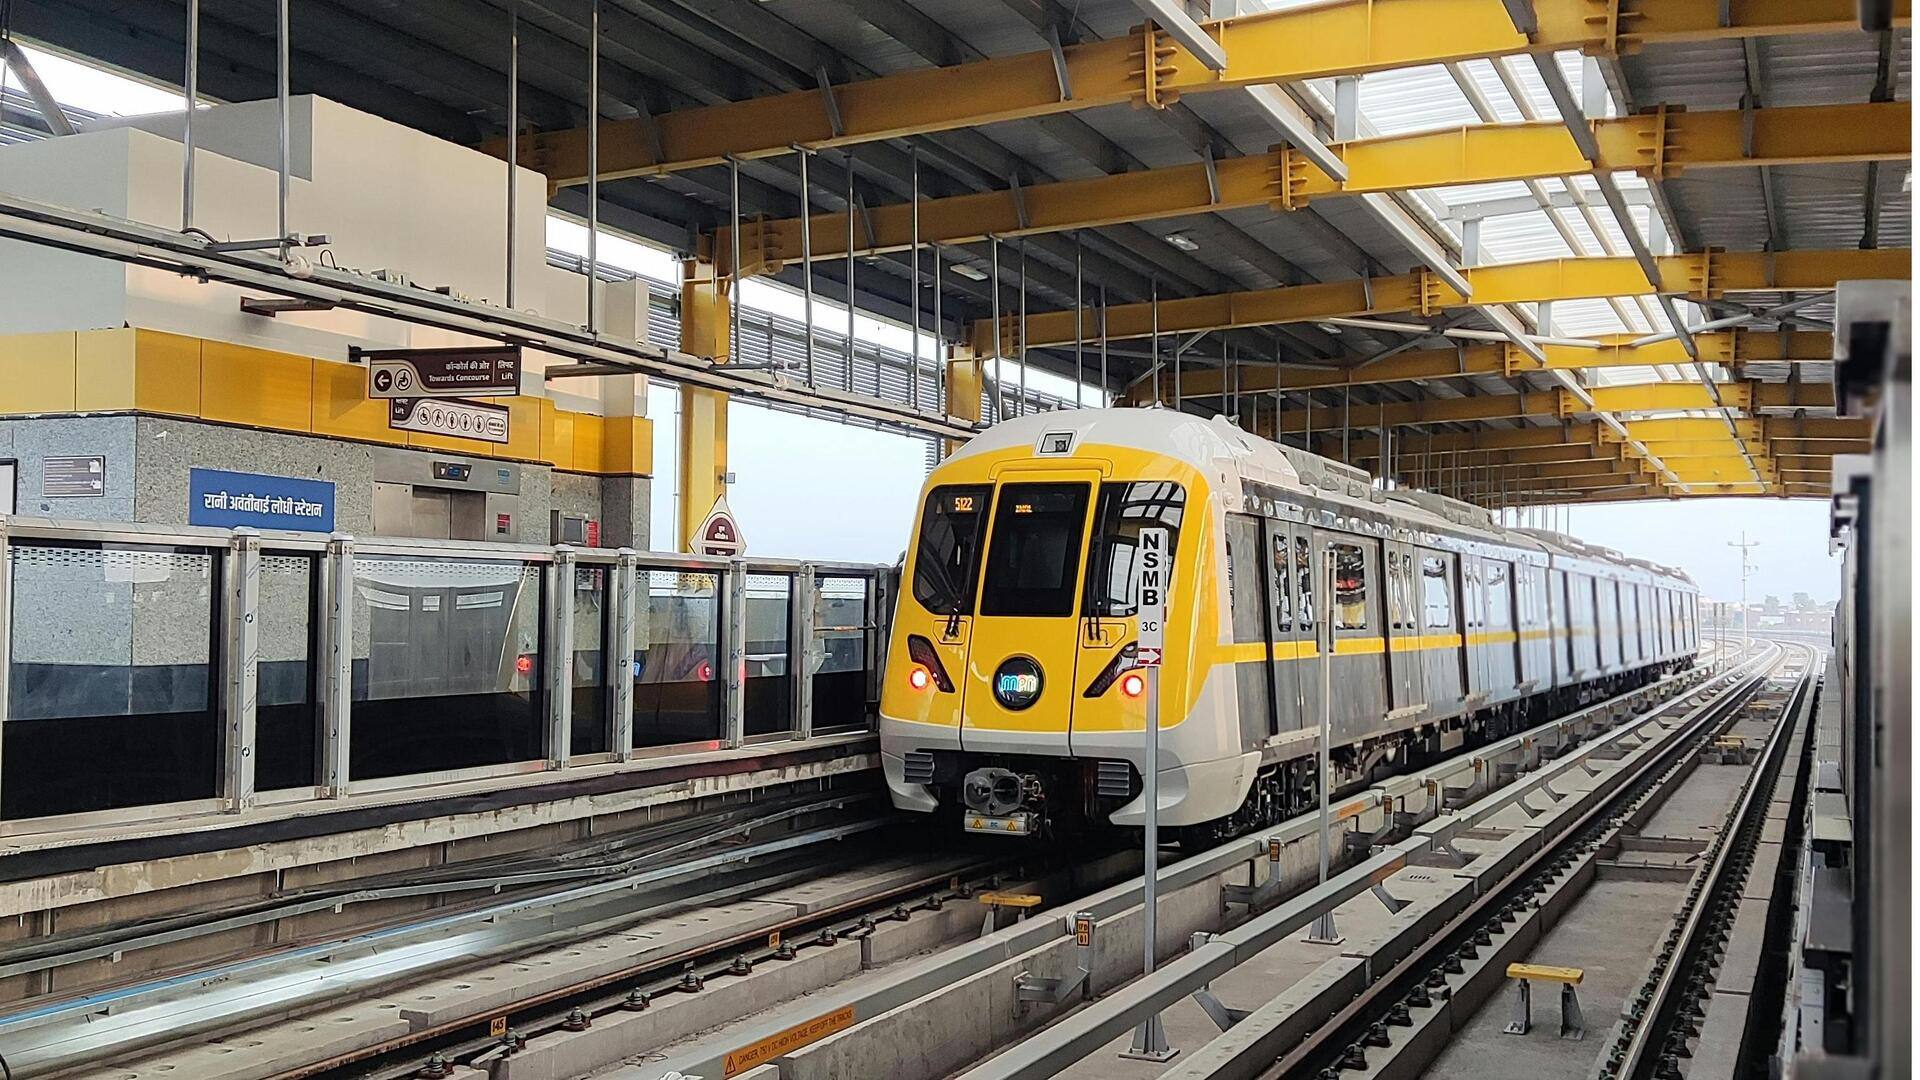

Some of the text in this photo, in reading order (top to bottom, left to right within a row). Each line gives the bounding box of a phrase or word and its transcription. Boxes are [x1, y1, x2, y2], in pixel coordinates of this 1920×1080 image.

[469, 360, 478, 370] की
[479, 360, 490, 370] ओर
[501, 372, 514, 380] Lift
[394, 407, 405, 415] Lift
[204, 491, 323, 517] रानी अवंतीबाई लोधी स्टेशन
[955, 497, 973, 511] 5122
[1142, 533, 1159, 606] NSMB
[1142, 621, 1158, 632] 3C
[492, 1018, 504, 1032] 145
